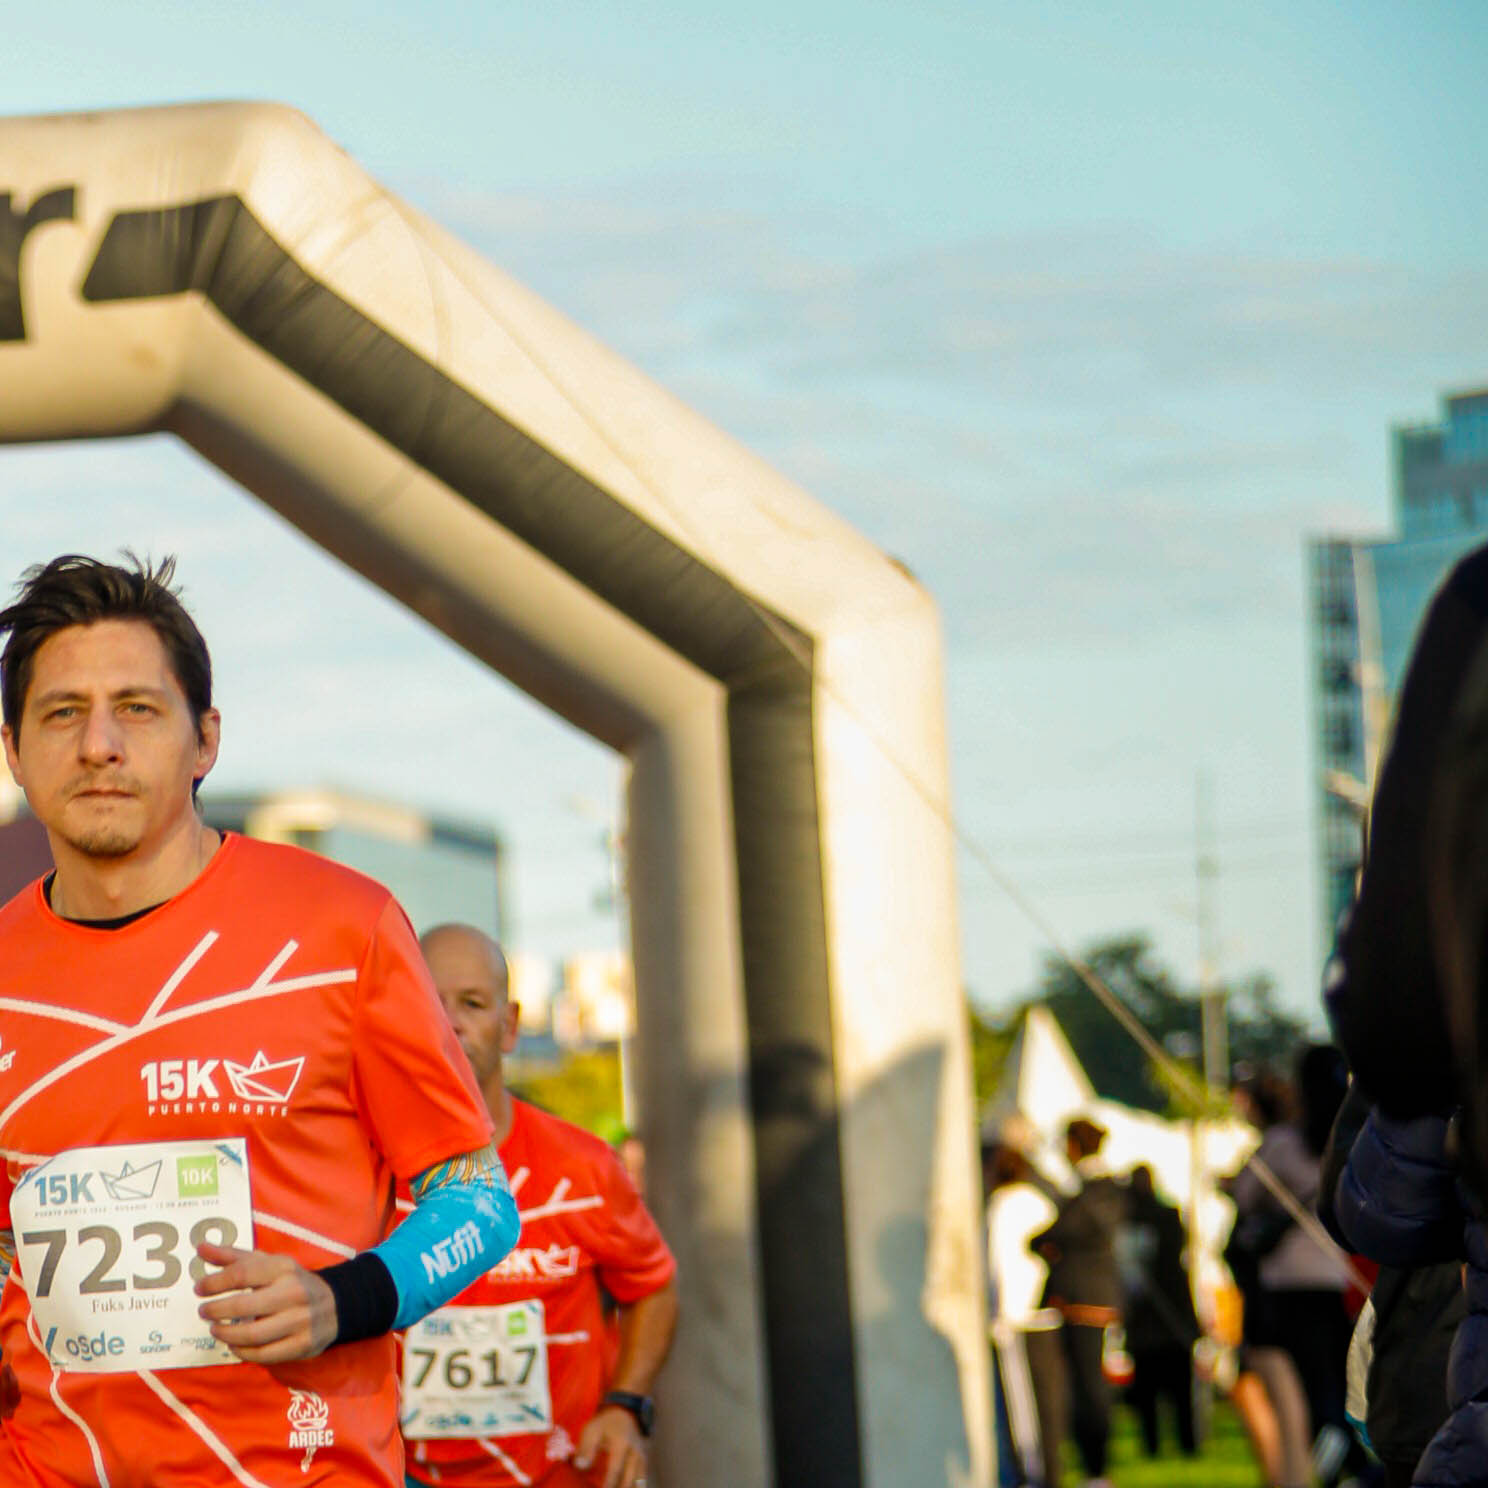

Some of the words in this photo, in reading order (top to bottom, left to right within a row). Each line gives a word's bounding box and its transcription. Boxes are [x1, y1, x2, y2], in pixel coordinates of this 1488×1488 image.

[140, 1059, 220, 1102] 15K
[148, 1103, 221, 1118] PUERTO
[227, 1101, 290, 1118] NORTE
[34, 1171, 97, 1206] 15K
[180, 1166, 215, 1186] 10K
[21, 1216, 239, 1299] 7238
[90, 1298, 125, 1313] Fuks
[128, 1295, 169, 1311] Javier
[65, 1330, 126, 1359] osde
[410, 1344, 539, 1390] 7617
[288, 1429, 335, 1449] ARDEC
